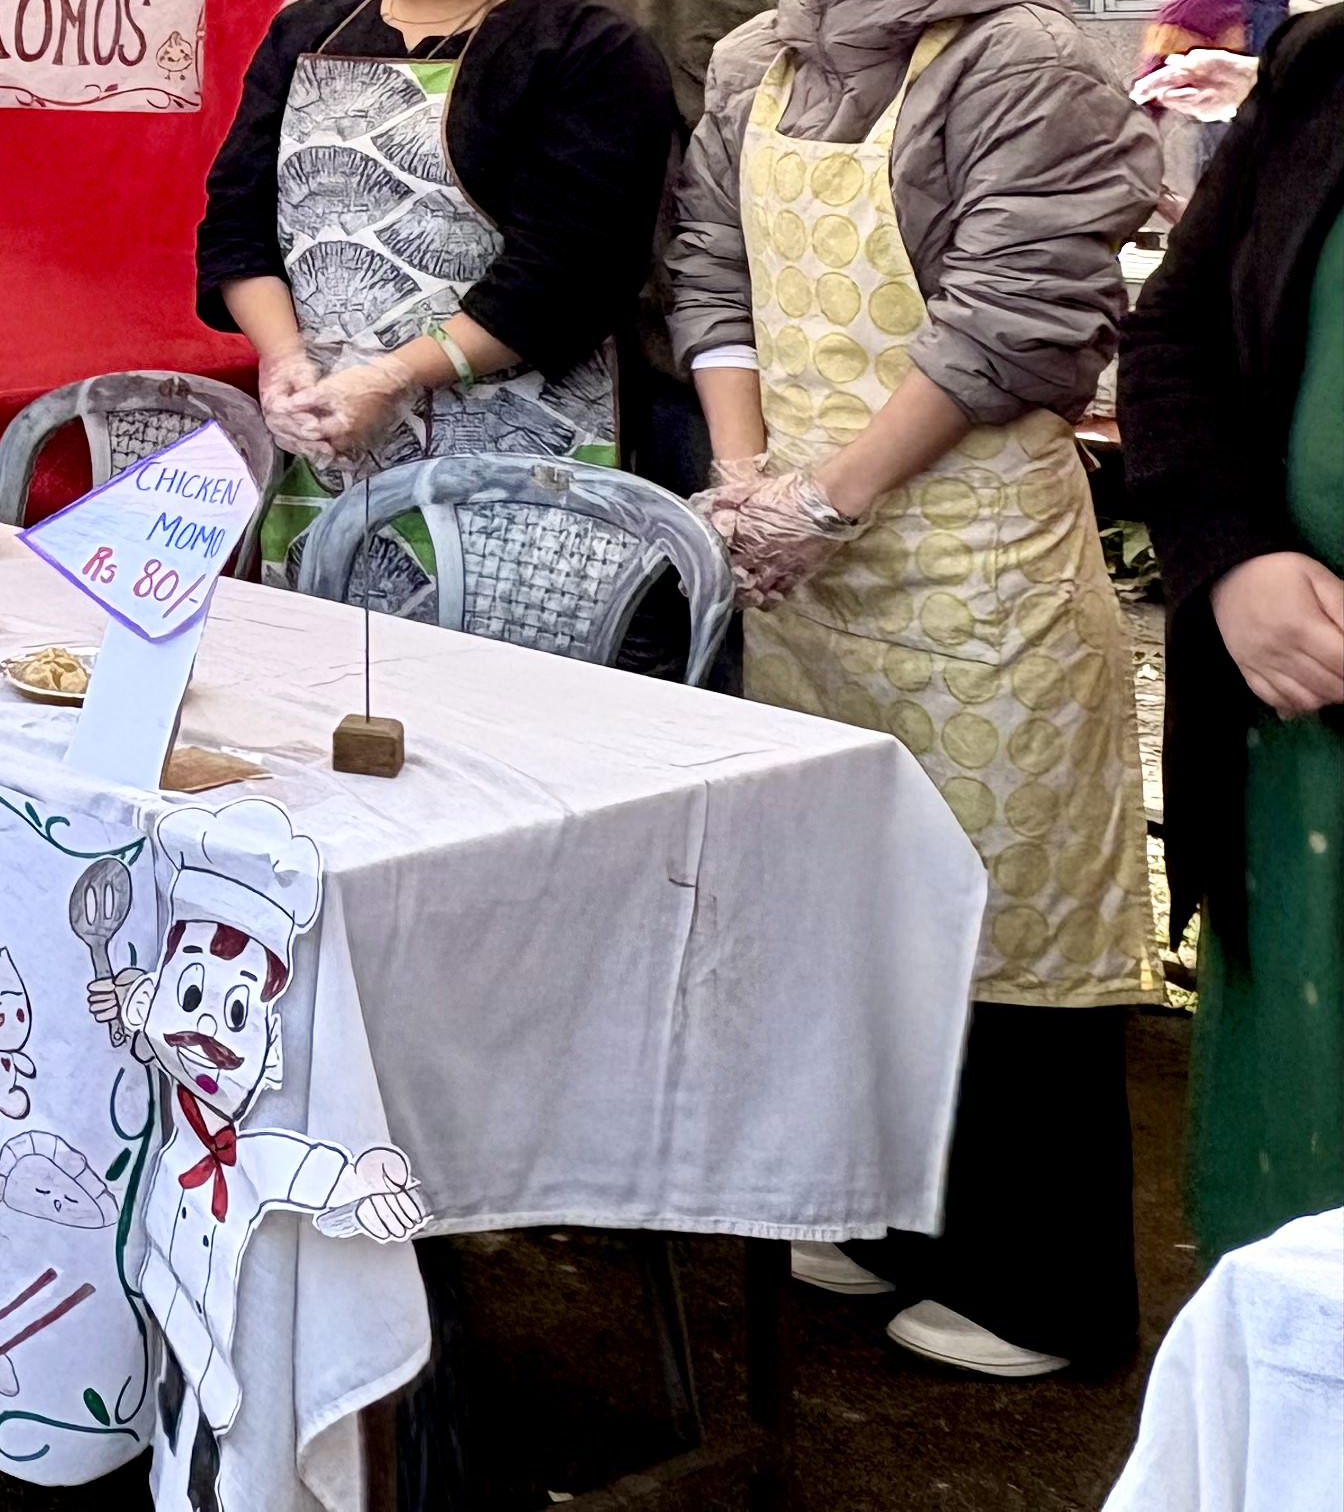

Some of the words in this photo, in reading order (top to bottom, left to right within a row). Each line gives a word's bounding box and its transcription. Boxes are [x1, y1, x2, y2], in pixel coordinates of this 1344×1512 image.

[136, 461, 243, 506] CHICKEN
[145, 512, 226, 559] MOMO
[82, 546, 117, 584] Rs
[133, 558, 206, 619] 80/-
